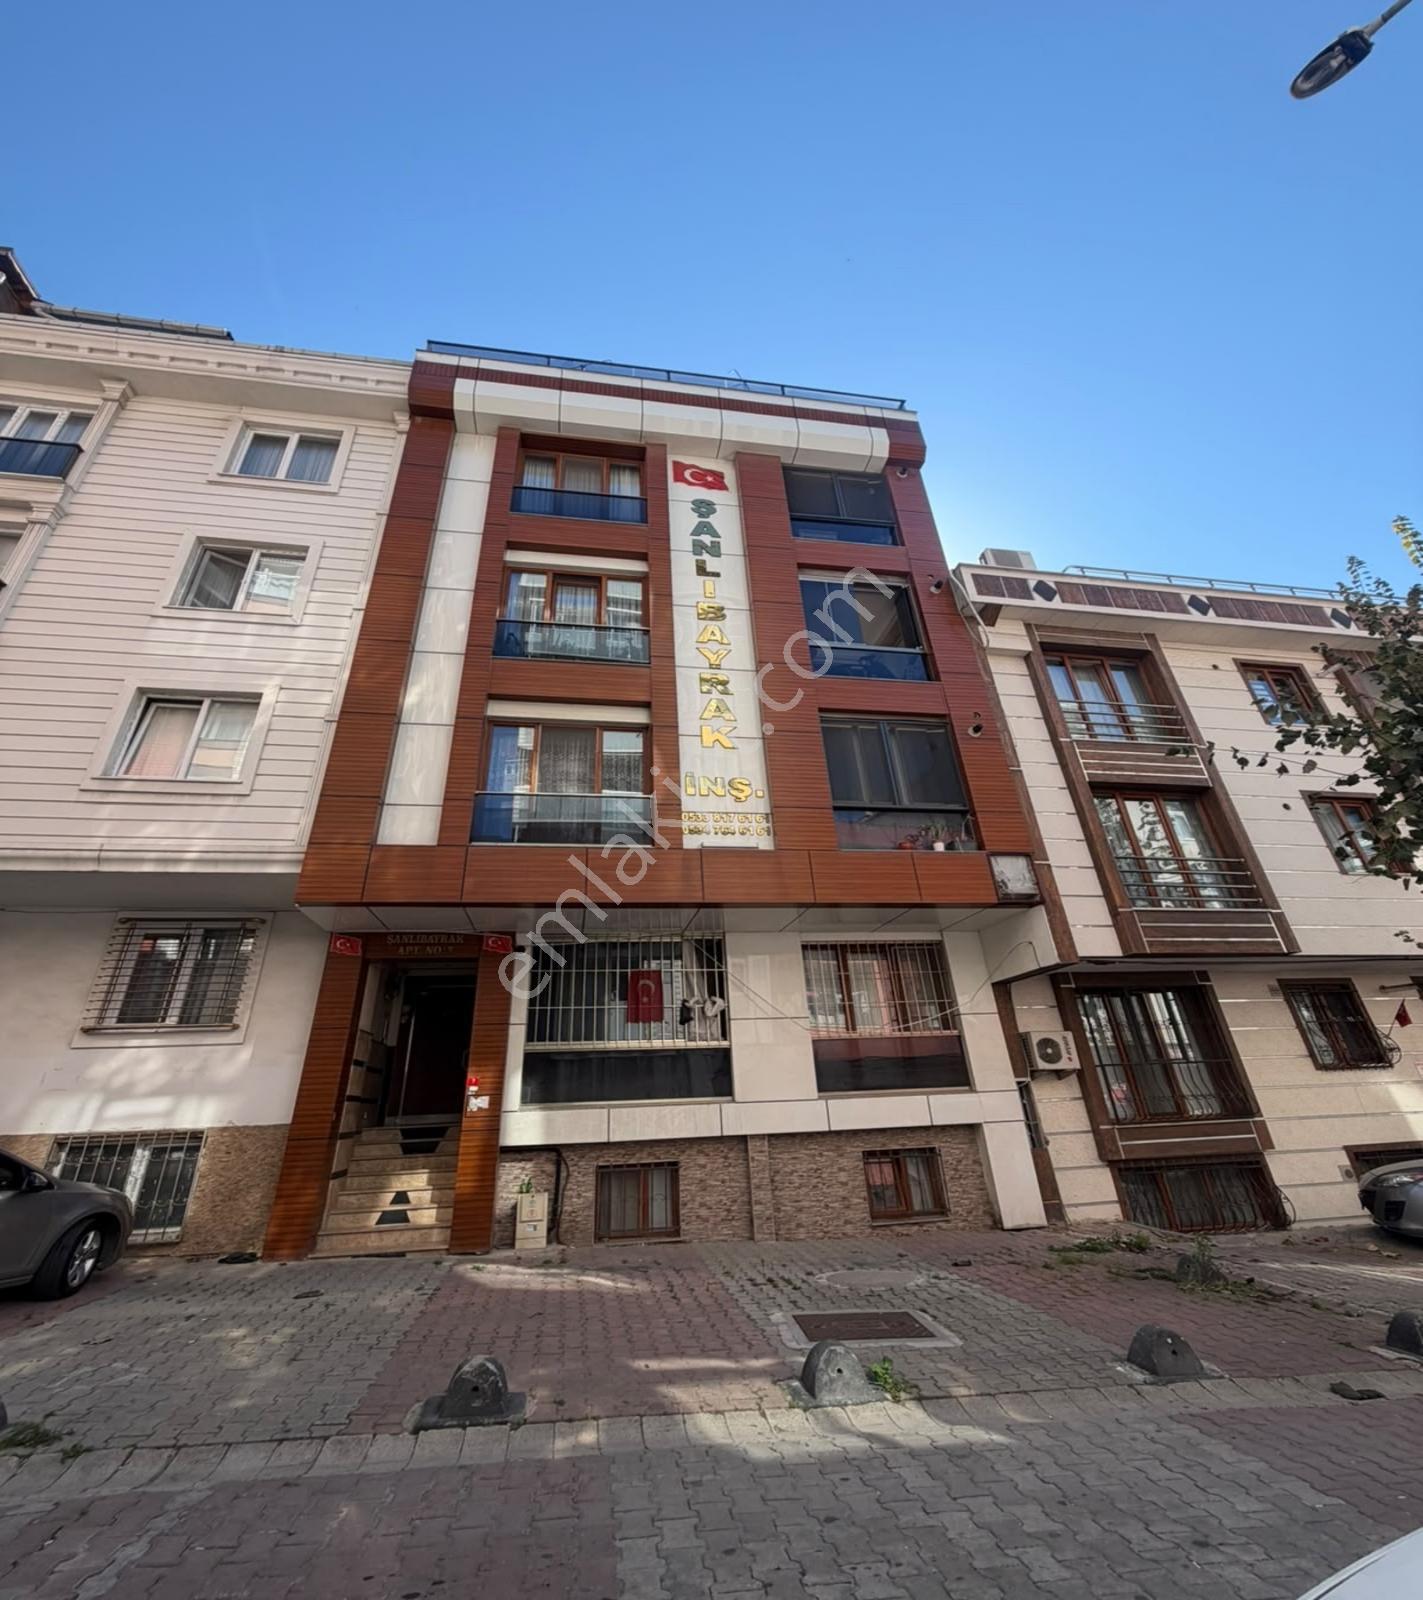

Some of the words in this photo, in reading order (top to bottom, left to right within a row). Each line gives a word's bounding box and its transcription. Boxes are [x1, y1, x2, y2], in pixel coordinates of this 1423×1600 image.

[684, 771, 765, 803] İNŞ.
[713, 813, 736, 823] 817
[738, 813, 754, 824] 61
[755, 813, 771, 824] 61
[738, 826, 754, 836] 61
[756, 826, 772, 837] 61
